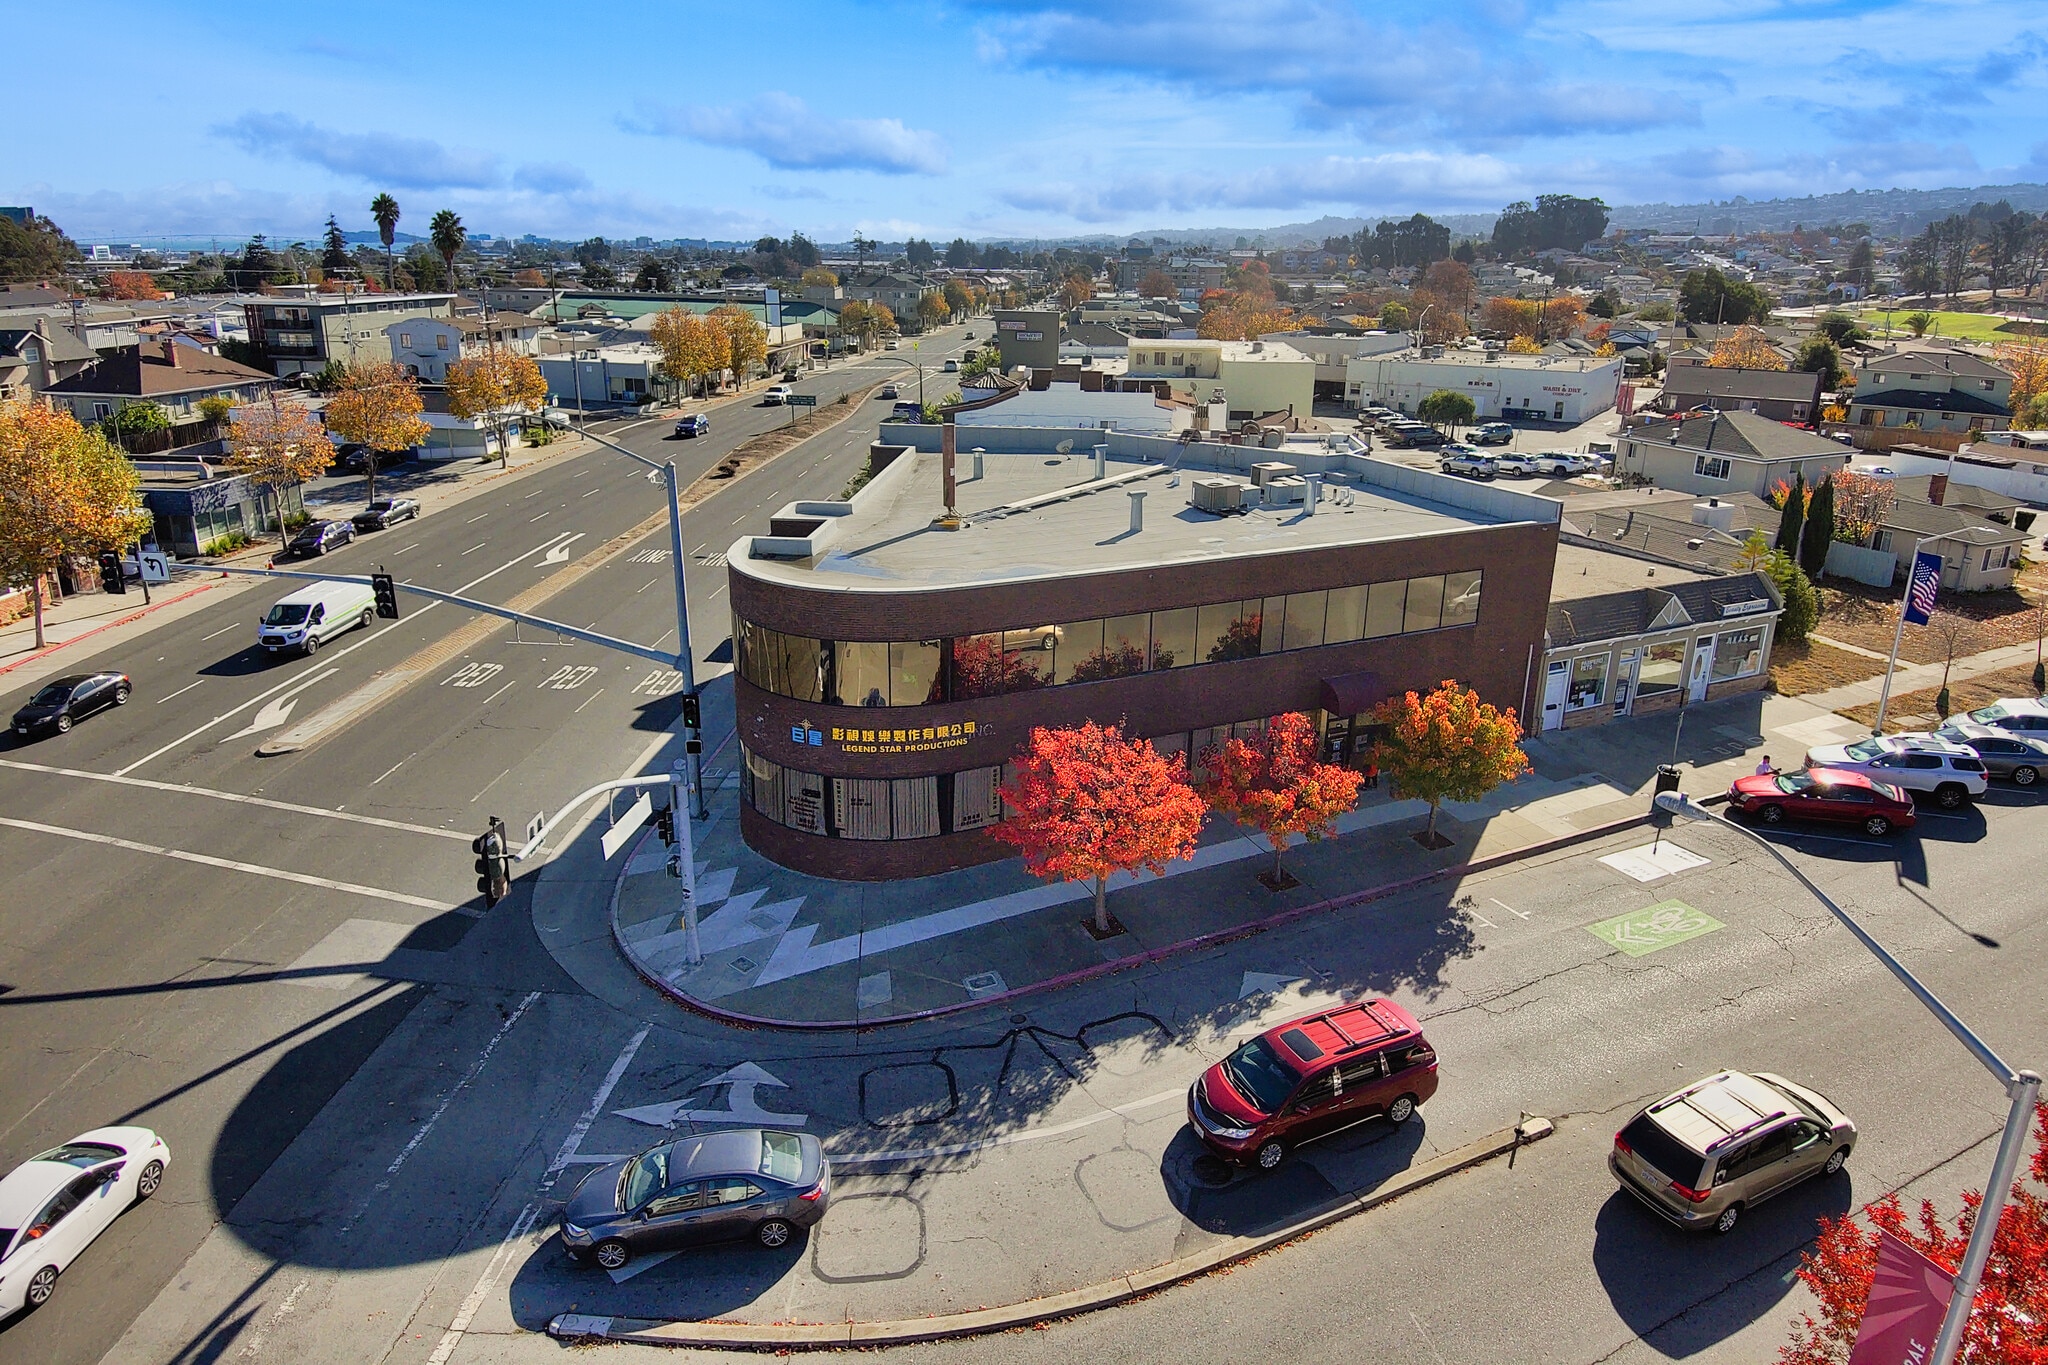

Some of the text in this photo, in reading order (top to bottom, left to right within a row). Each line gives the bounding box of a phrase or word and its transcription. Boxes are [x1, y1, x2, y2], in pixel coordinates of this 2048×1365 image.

[440, 662, 504, 688] PED
[537, 665, 599, 690] PED
[791, 726, 823, 746] 巨星
[841, 737, 968, 753] LEGEND STAR PRODUCTIONS
